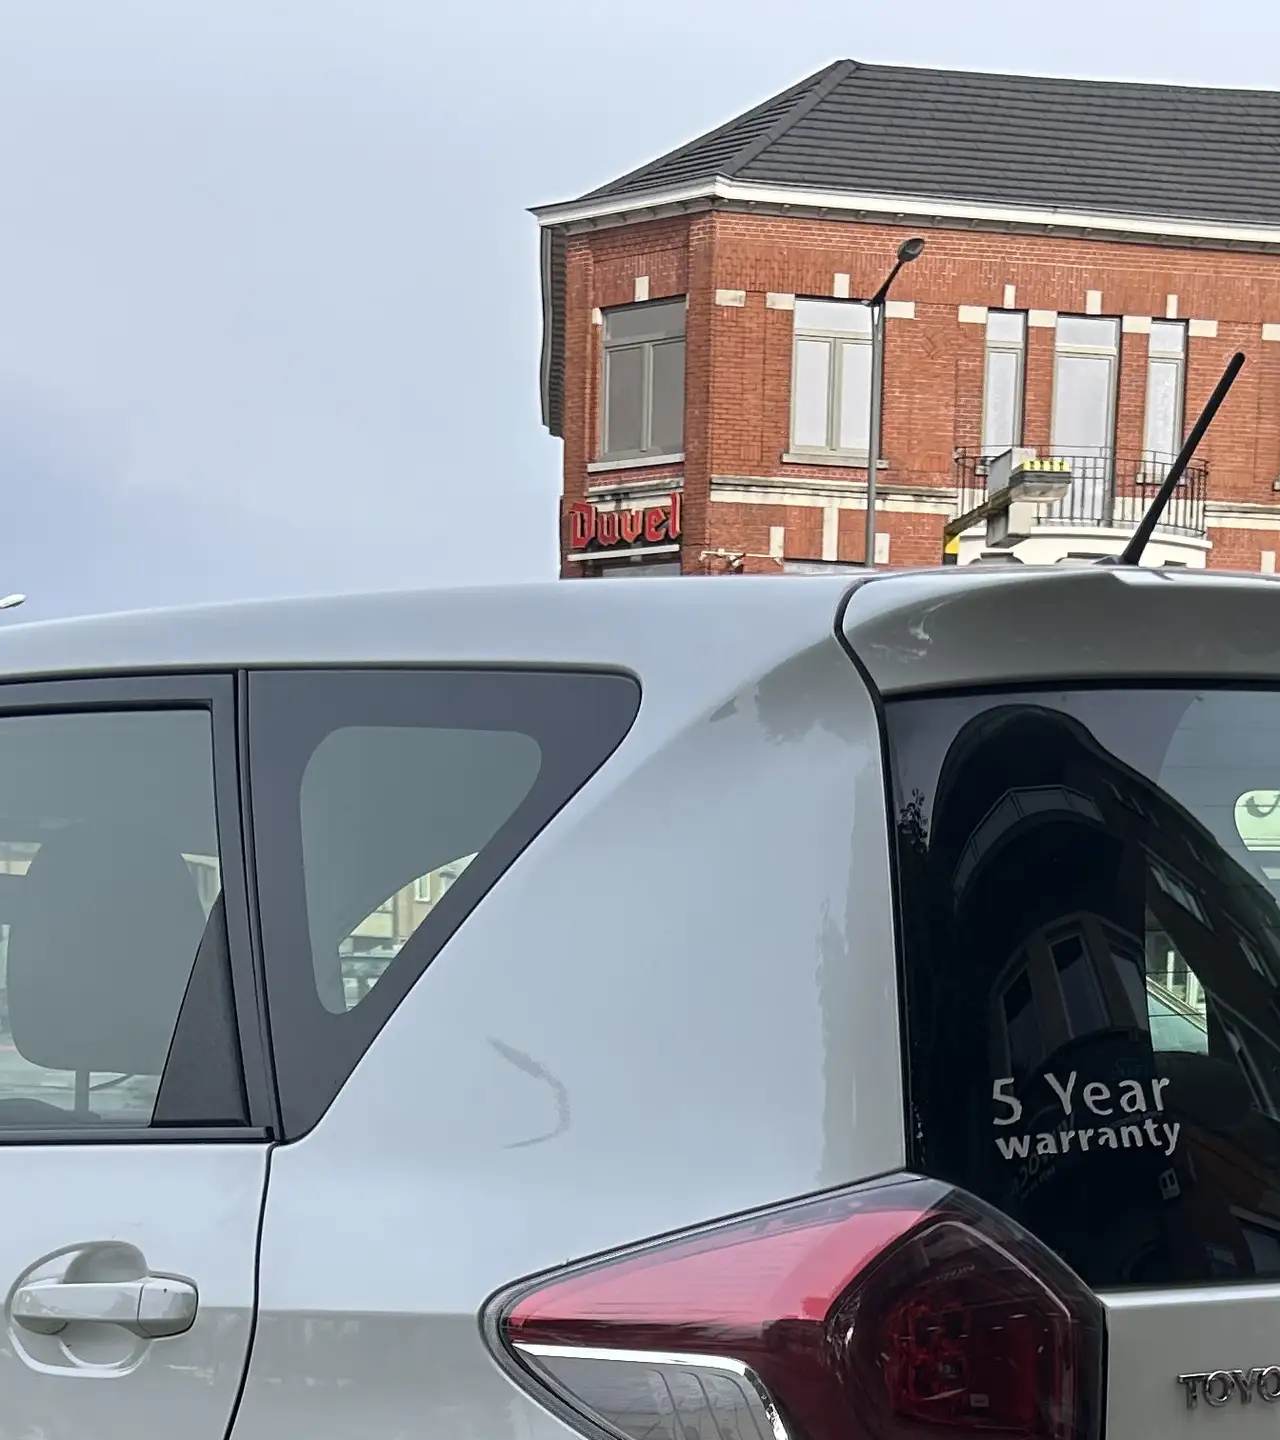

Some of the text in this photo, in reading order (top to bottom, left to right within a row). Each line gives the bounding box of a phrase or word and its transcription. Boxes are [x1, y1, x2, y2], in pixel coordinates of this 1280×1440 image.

[570, 492, 681, 548] Duvel
[992, 1070, 1171, 1126] 5 Year
[994, 1118, 1181, 1160] warranty
